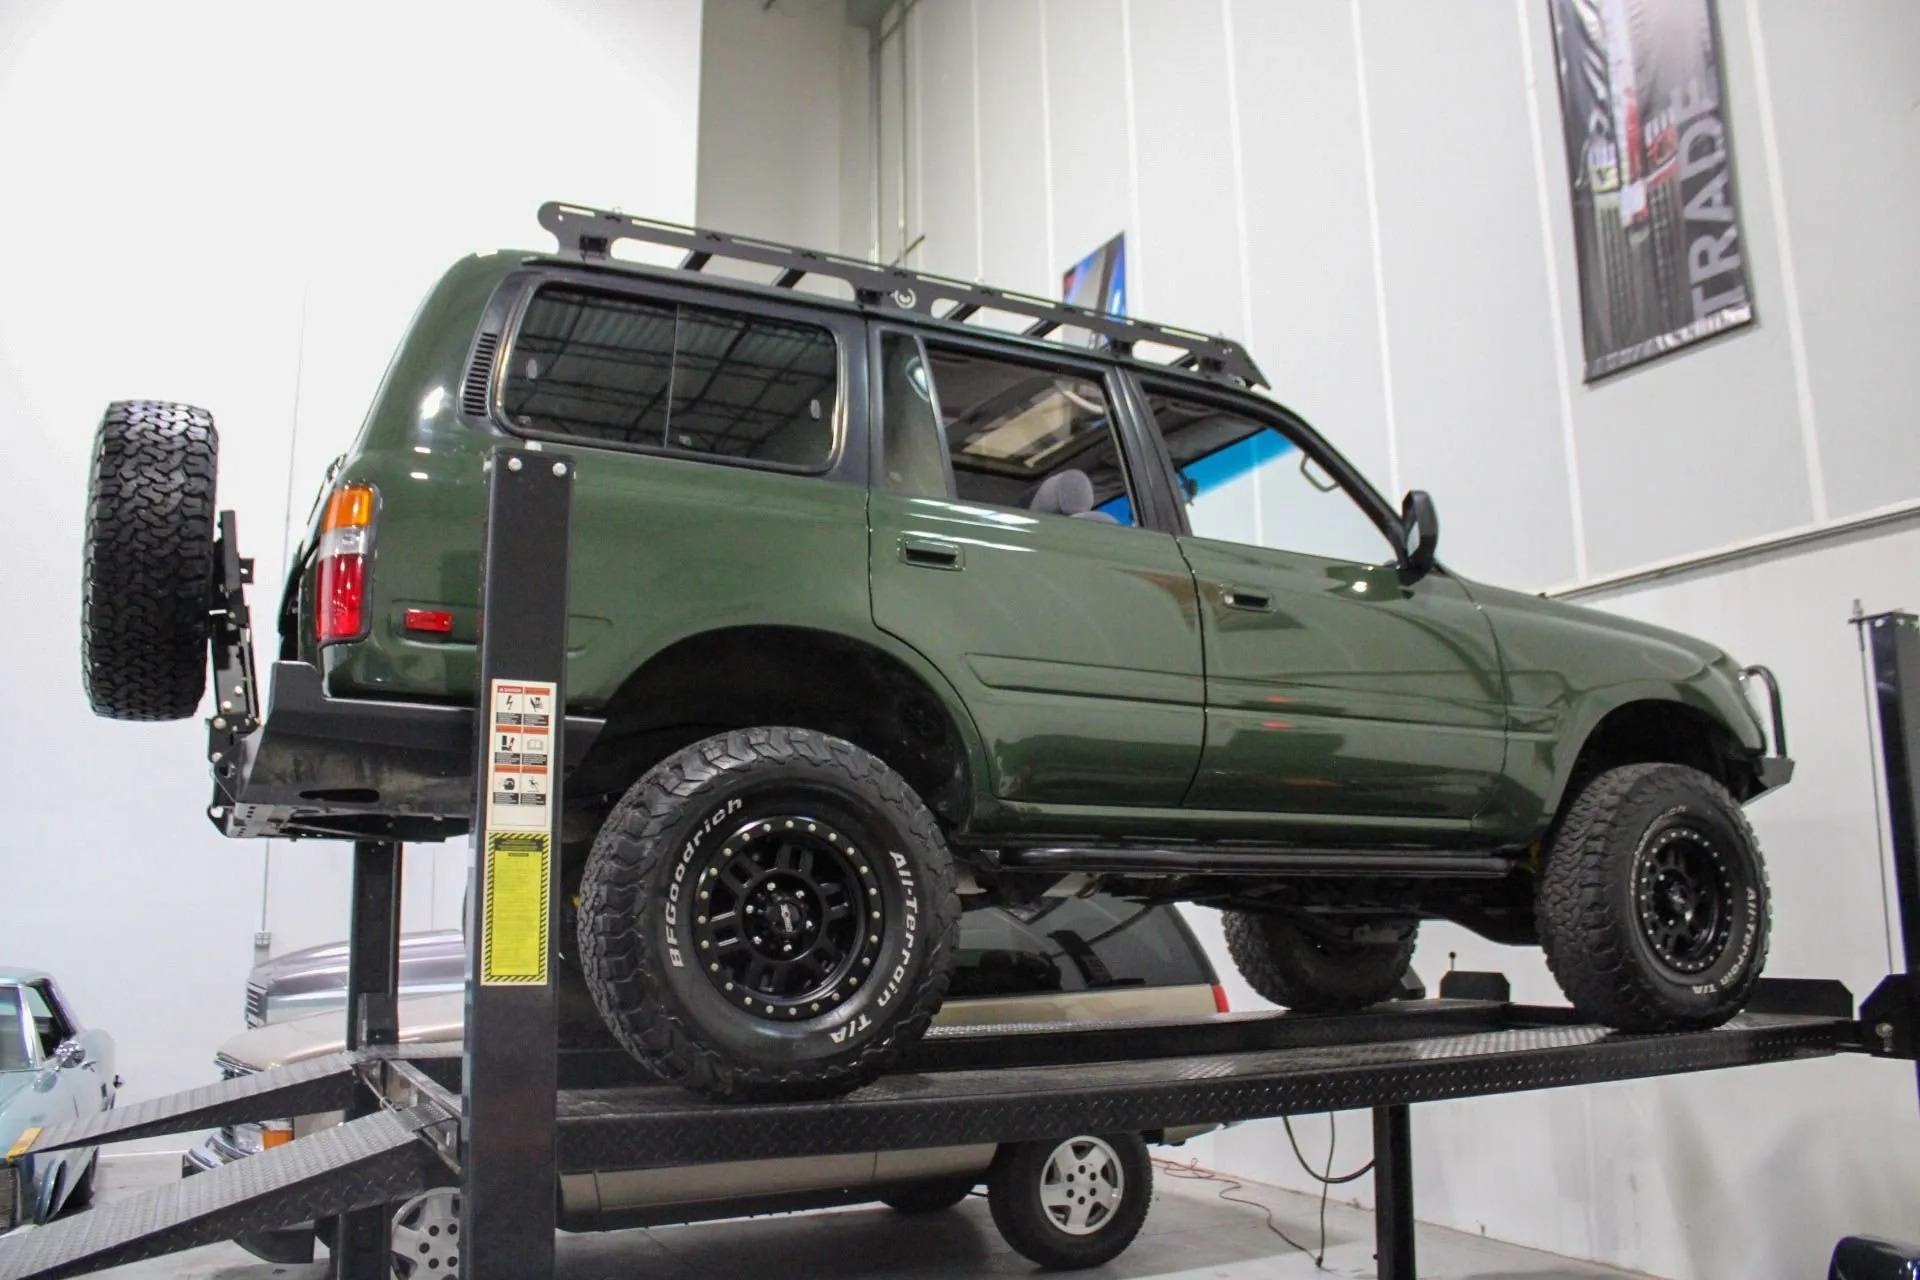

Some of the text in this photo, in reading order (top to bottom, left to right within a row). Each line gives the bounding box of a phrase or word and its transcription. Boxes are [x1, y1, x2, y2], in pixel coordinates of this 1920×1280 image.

[664, 797, 742, 968] BFGoodrich
[828, 850, 919, 1044] All-Terrain T/A
